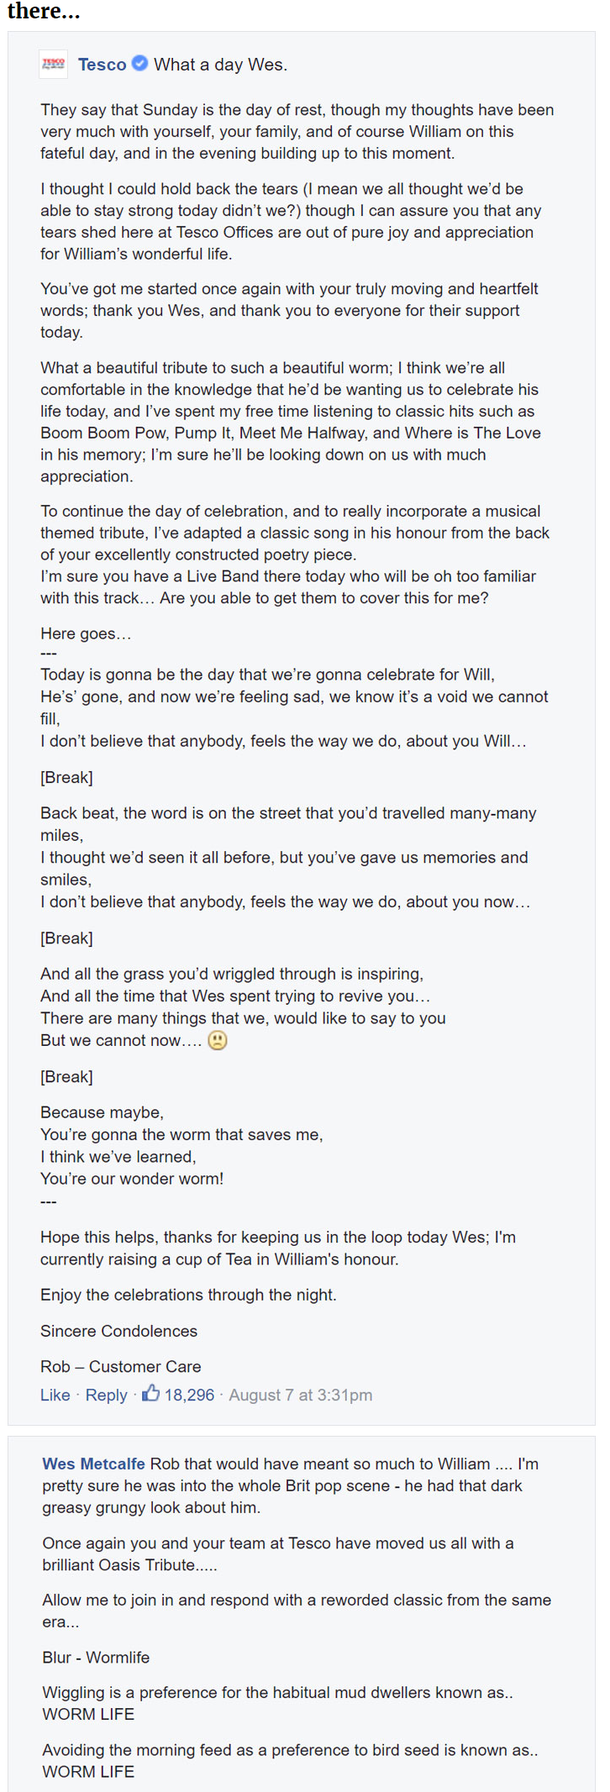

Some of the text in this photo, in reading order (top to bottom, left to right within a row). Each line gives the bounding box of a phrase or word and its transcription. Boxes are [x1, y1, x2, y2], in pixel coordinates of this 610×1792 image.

[78, 58, 287, 74] Tesco What a day Wes.
[42, 1708, 134, 1720] WORM LIFE
